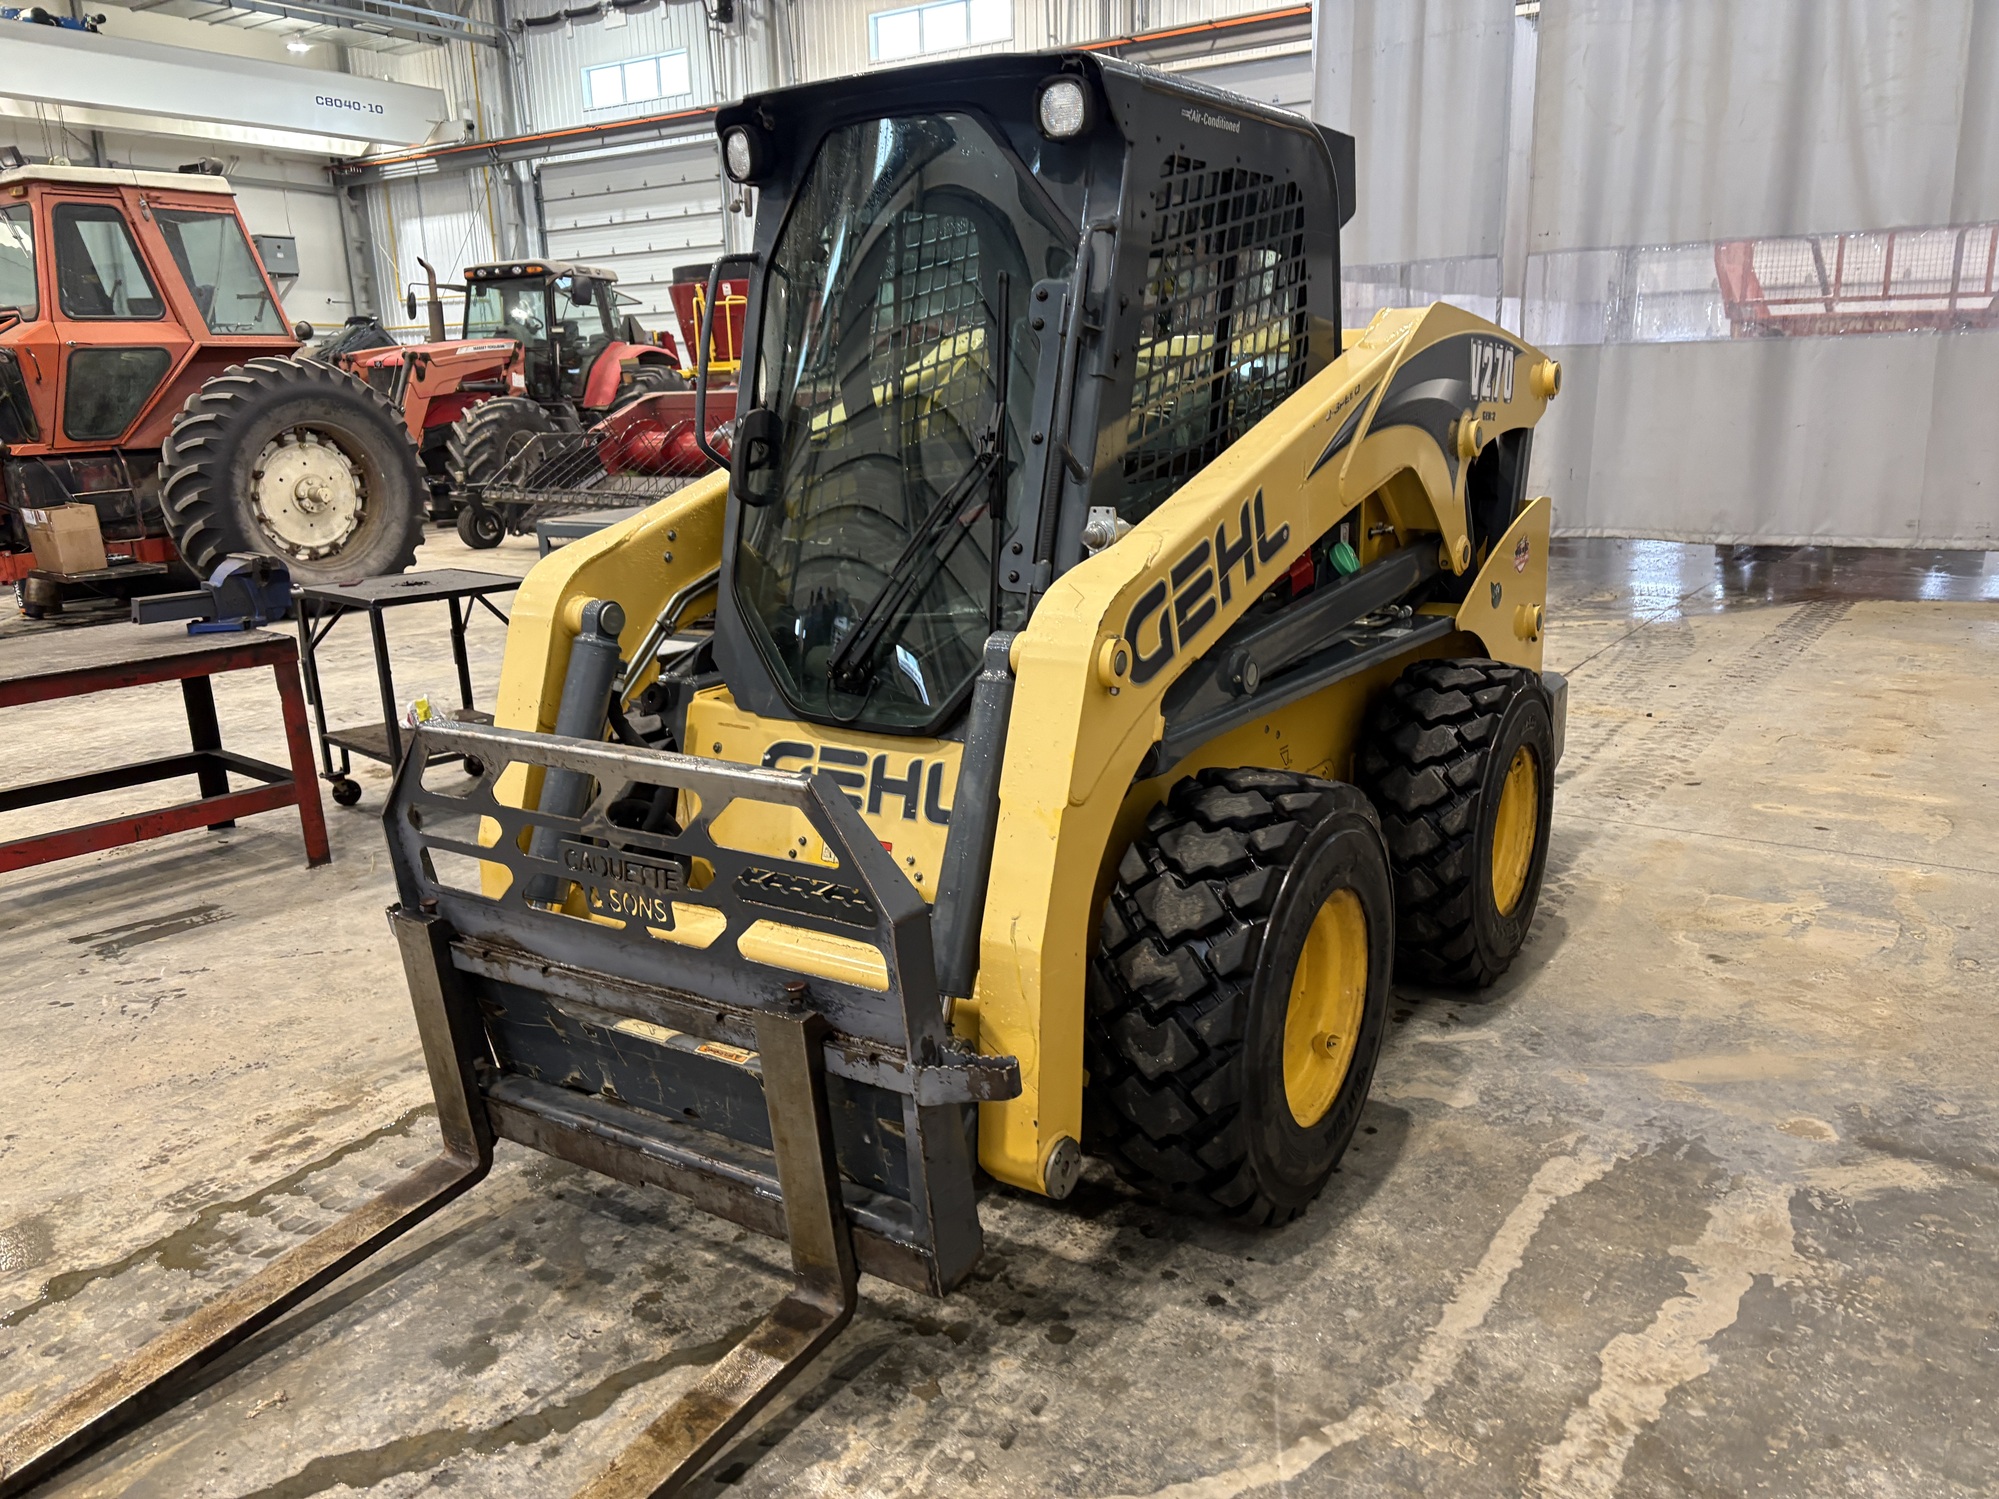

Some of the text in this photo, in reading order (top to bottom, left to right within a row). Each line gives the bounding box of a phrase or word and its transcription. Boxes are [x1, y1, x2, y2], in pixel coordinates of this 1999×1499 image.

[1191, 109, 1241, 134] Air-Conditioned
[1470, 338, 1515, 404] V270
[1123, 484, 1290, 686] GEHL
[590, 885, 668, 923] & SONS
